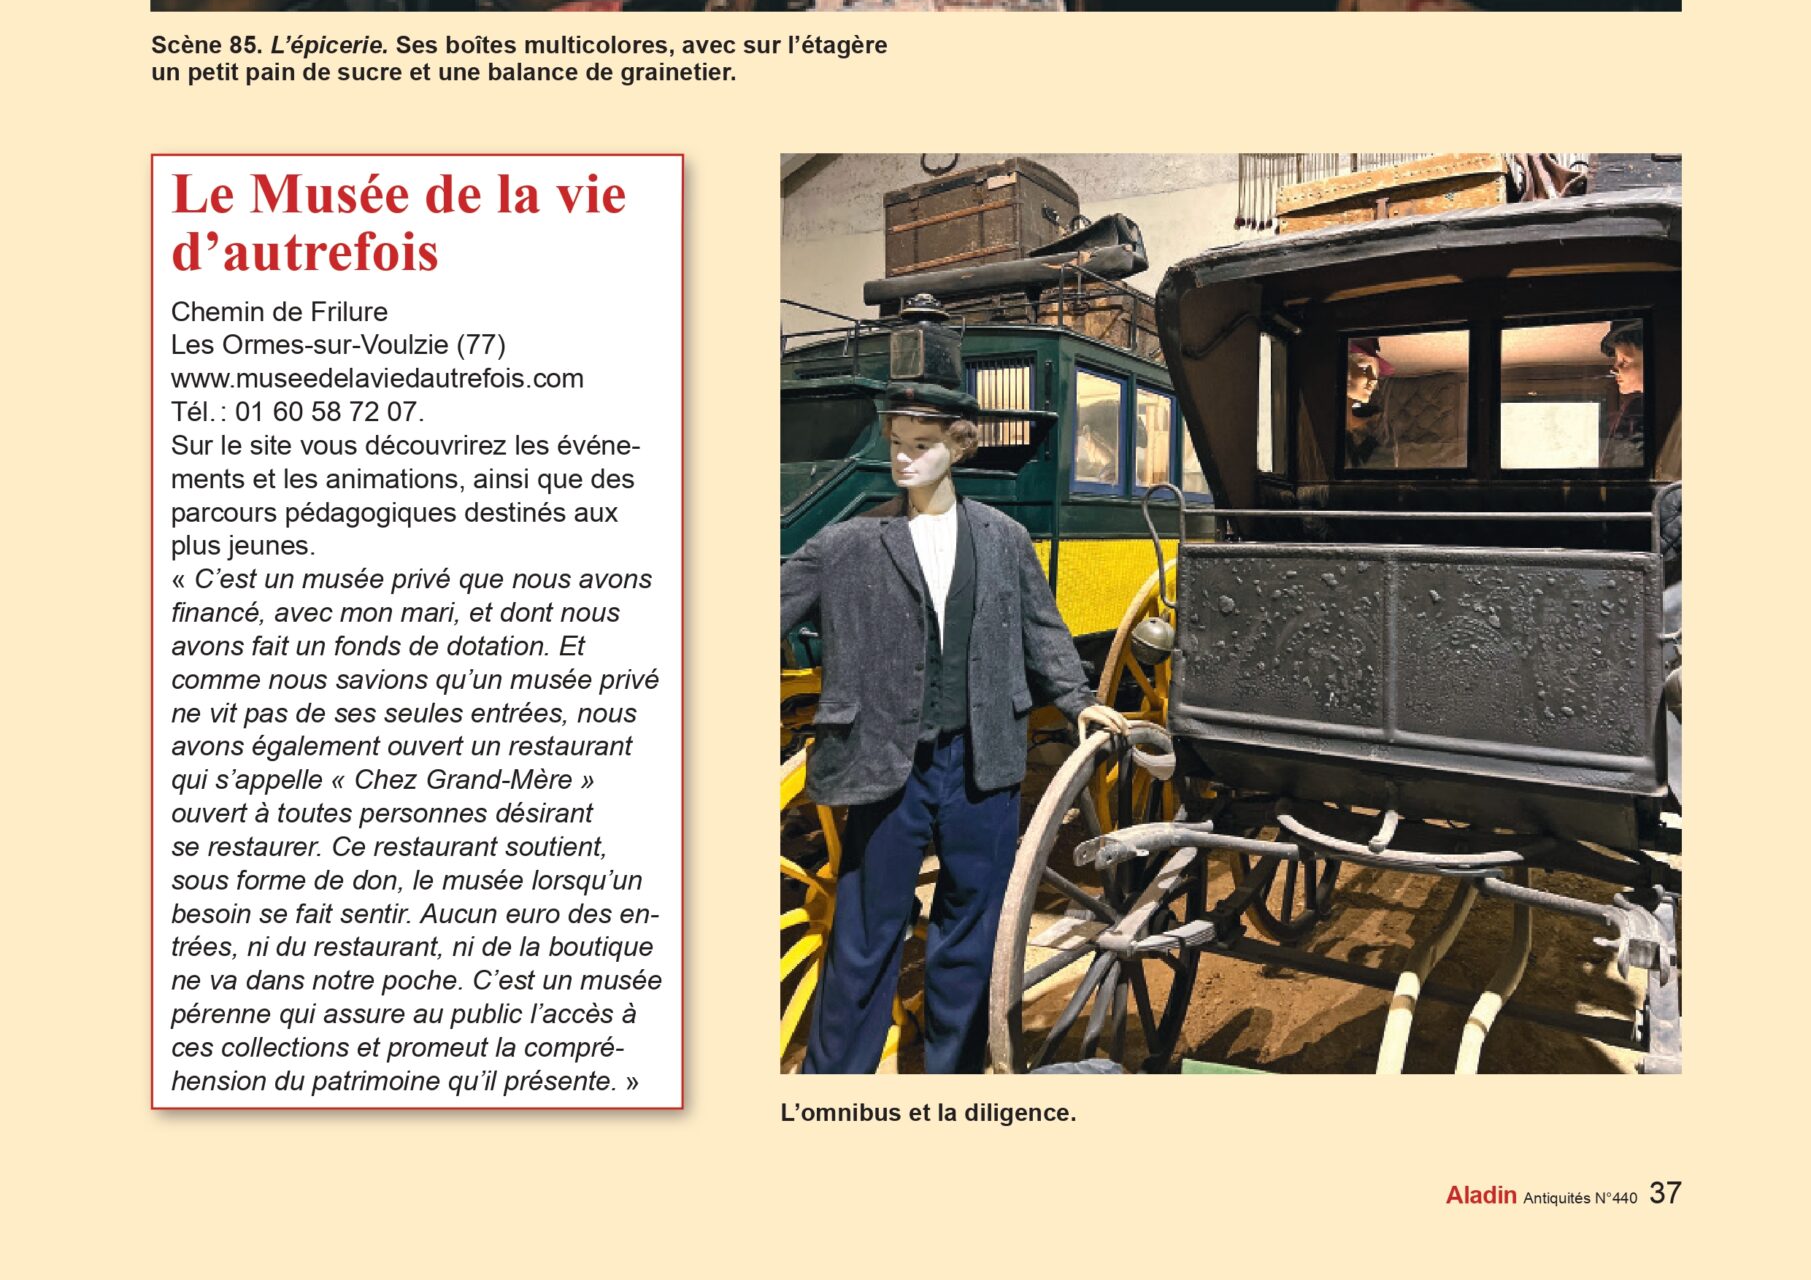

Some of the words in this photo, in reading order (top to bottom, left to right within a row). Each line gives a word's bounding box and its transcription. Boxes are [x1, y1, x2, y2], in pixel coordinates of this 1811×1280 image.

[151, 34, 222, 54] Scène
[229, 35, 262, 54] 85.
[396, 35, 438, 54] Ses
[446, 35, 517, 54] boîtes
[524, 35, 675, 58] multicolores,
[681, 39, 736, 54] avec
[743, 39, 782, 54] sur
[151, 66, 180, 81] un
[188, 62, 239, 87] petit
[246, 62, 295, 87] pain
[302, 62, 331, 81] de
[337, 66, 403, 81] sucre
[409, 62, 431, 81] et
[438, 66, 481, 81] une
[488, 62, 579, 81] balance
[585, 62, 614, 81] de
[620, 62, 736, 87] grainetier.
[171, 173, 234, 214] Le
[249, 172, 409, 214] Musée
[425, 173, 481, 214] de
[497, 173, 541, 214] la
[555, 172, 626, 214] vie
[171, 300, 264, 322] Chemin
[272, 300, 303, 322] de
[311, 300, 388, 322] Frilure
[172, 333, 215, 355] Les
[222, 333, 449, 355] Ormes-sur-Voulzie
[457, 333, 506, 361] (77)
[170, 367, 584, 389] www.museedelaviedautrefois.com
[235, 400, 261, 422] 01
[273, 400, 304, 422] 60
[311, 400, 342, 422] 58
[349, 400, 379, 422] 72
[387, 400, 424, 422] 07.
[171, 434, 214, 456] Sur
[221, 434, 242, 456] le
[250, 434, 292, 456] site
[299, 439, 358, 456] vous
[365, 434, 507, 456] découvrirez
[515, 434, 550, 456] les
[557, 434, 641, 456] événe-
[171, 506, 277, 529] parcours
[285, 501, 457, 529] pédagogiques
[464, 501, 567, 523] destinés
[574, 506, 619, 523] aux
[171, 534, 221, 562] plus
[226, 534, 315, 562] jeunes.
[264, 572, 295, 589] un
[301, 567, 385, 589] musée
[390, 567, 451, 595] privé
[459, 572, 504, 595] que
[512, 572, 572, 589] nous
[578, 572, 653, 589] avons
[171, 600, 264, 626] financé,
[274, 606, 334, 623] avec
[339, 606, 393, 623] mon
[400, 601, 459, 626] mari,
[469, 601, 494, 623] et
[500, 601, 555, 623] dont
[560, 606, 621, 623] nous
[171, 673, 261, 690] comme
[268, 673, 328, 690] nous
[335, 668, 429, 690] savions
[509, 667, 593, 690] musée
[598, 667, 660, 696] privé
[171, 739, 245, 757] avons
[251, 734, 382, 762] également
[387, 735, 465, 757] ouvert
[471, 740, 501, 757] un
[508, 735, 634, 757] restaurant
[171, 768, 209, 796] qui
[355, 768, 418, 790] Chez
[426, 767, 573, 790] Grand-Mère
[171, 802, 249, 824] ouvert
[254, 801, 270, 824] à
[277, 802, 353, 824] toutes
[358, 807, 488, 830] personnes
[495, 801, 595, 824] désirant
[171, 840, 200, 857] se
[207, 836, 321, 857] restaurer.
[332, 835, 366, 857] Ce
[373, 836, 499, 857] restaurant
[504, 835, 606, 861] soutient,
[170, 1001, 271, 1030] pérenne
[279, 1002, 317, 1030] qui
[323, 1007, 406, 1024] assure
[413, 1007, 444, 1024] au
[449, 1002, 523, 1030] public
[621, 1002, 637, 1024] à
[171, 1041, 214, 1058] ces
[221, 1036, 350, 1058] collections
[357, 1036, 381, 1058] et
[386, 1036, 489, 1064] promeut
[495, 1036, 517, 1058] la
[524, 1035, 625, 1064] compré-
[171, 1069, 267, 1092] hension
[274, 1069, 306, 1091] du
[310, 1069, 441, 1097] patrimoine
[502, 1069, 616, 1097] présente.
[908, 1103, 931, 1122] et
[938, 1102, 957, 1122] la
[964, 1102, 1076, 1127] diligence.
[1445, 1185, 1517, 1205] Aladin
[1523, 1191, 1591, 1207] Antiquités
[1595, 1191, 1638, 1205] N°440
[1649, 1180, 1683, 1205] 37
